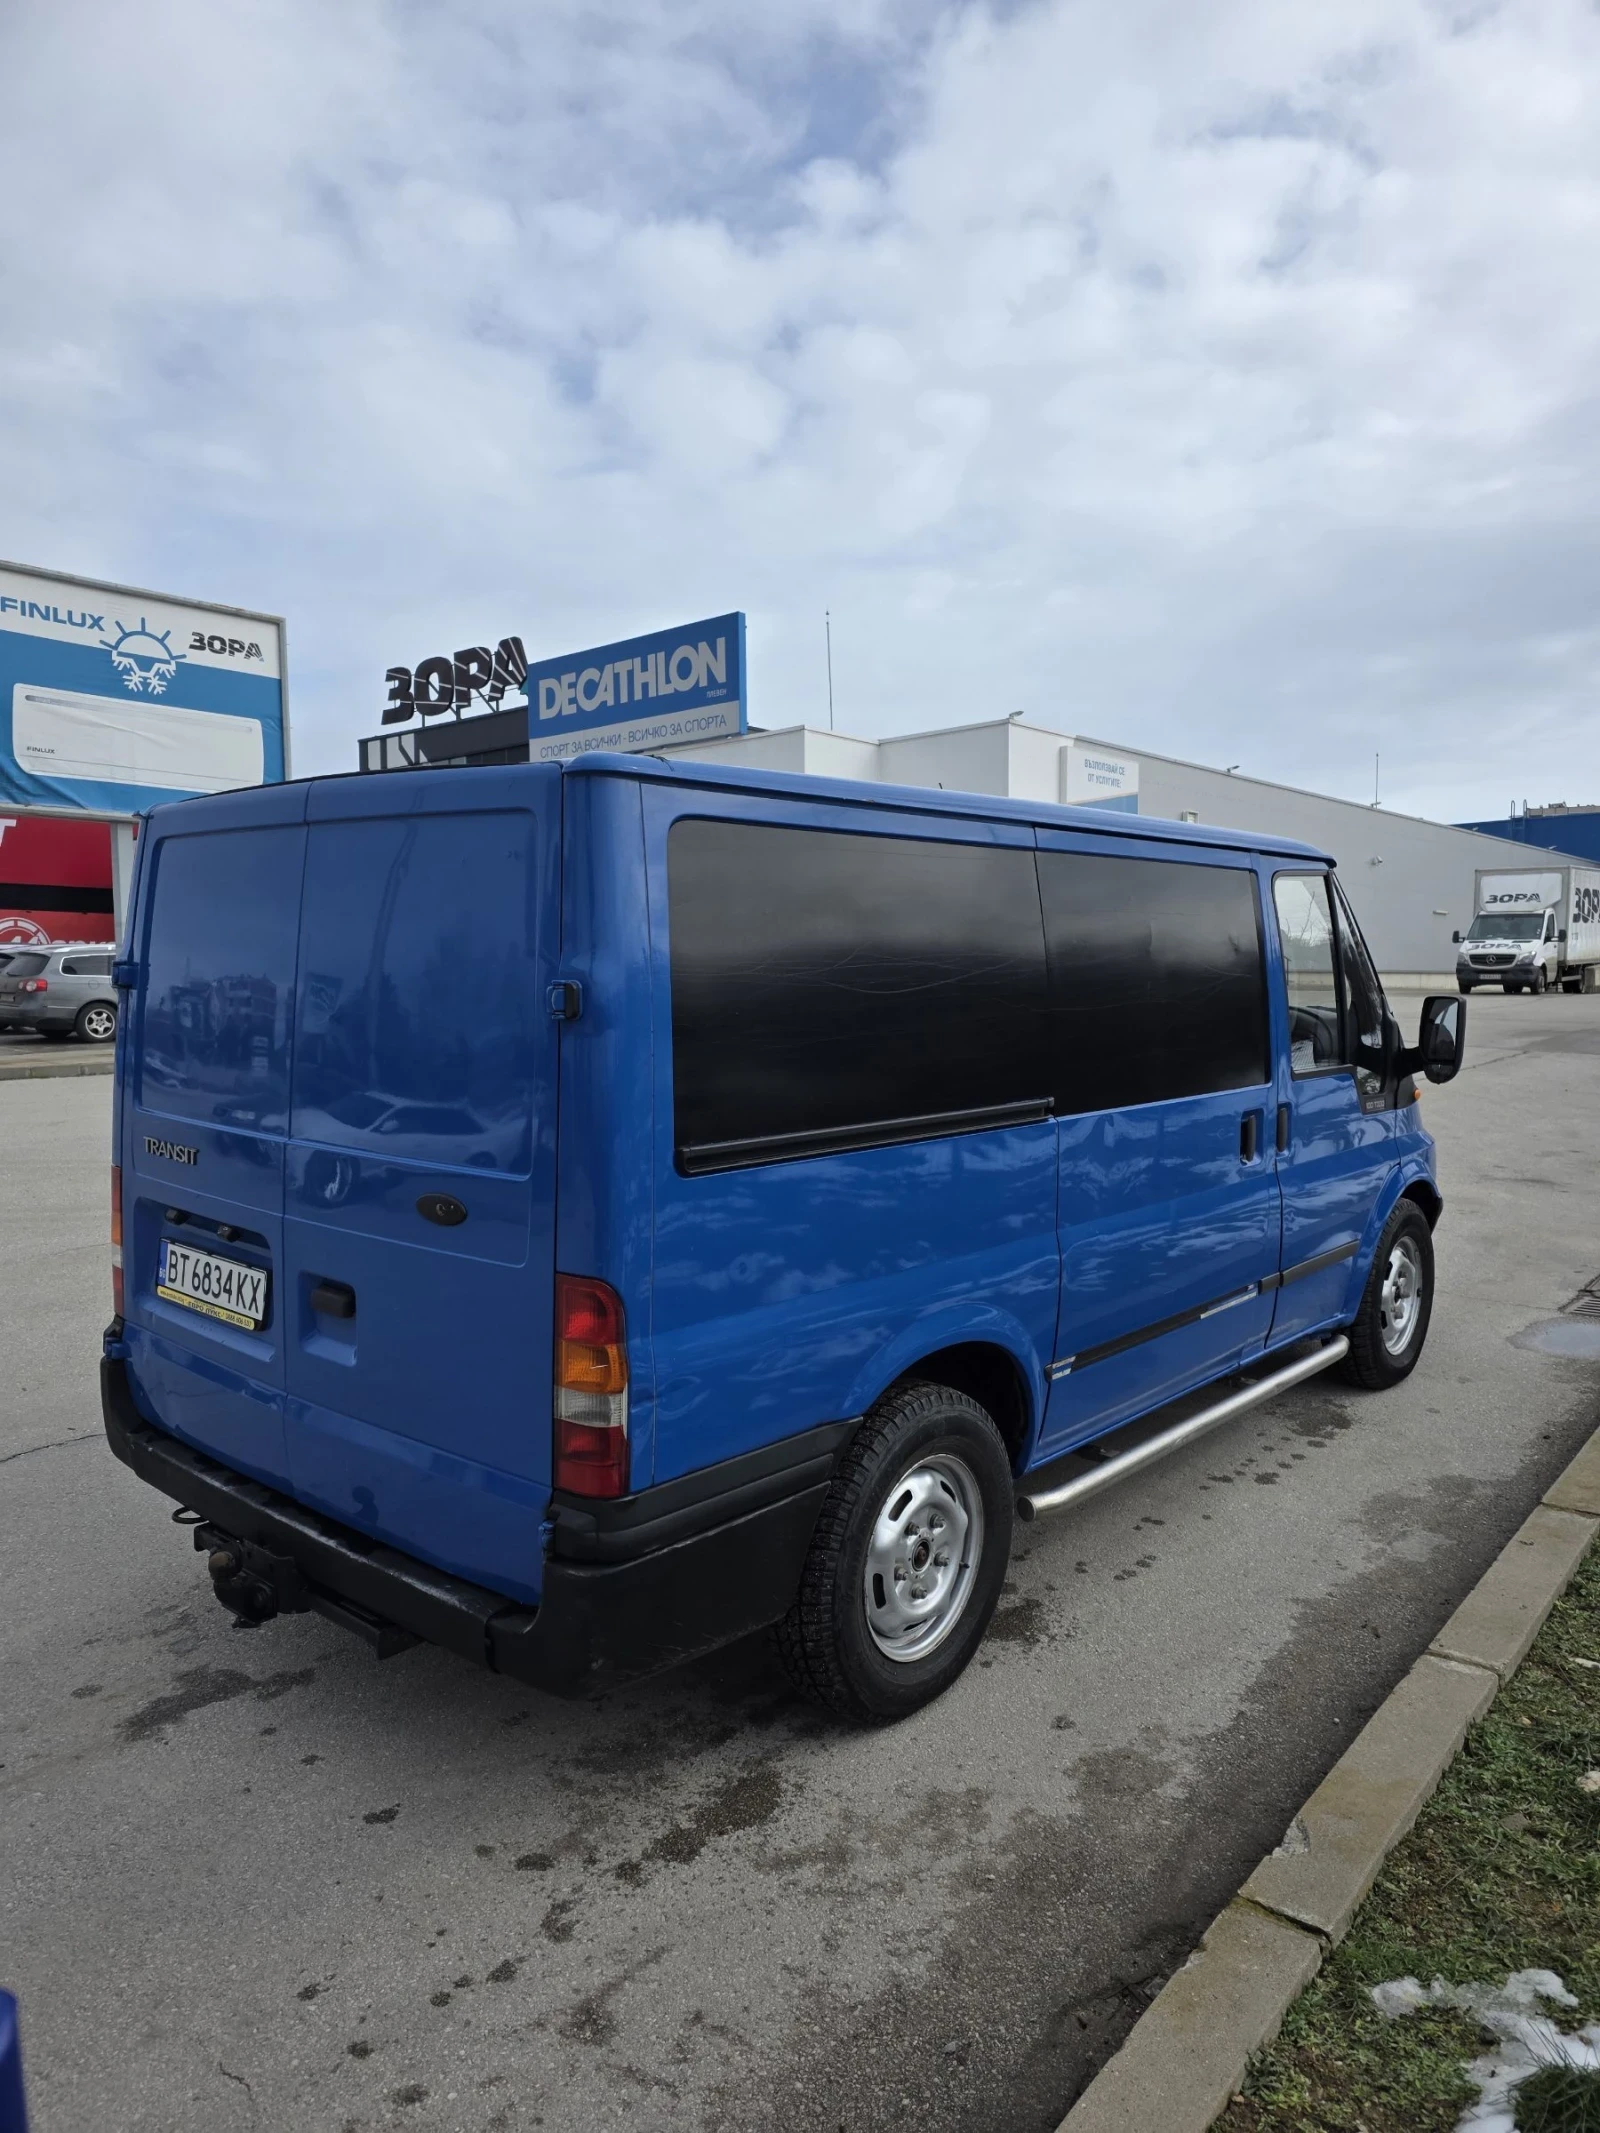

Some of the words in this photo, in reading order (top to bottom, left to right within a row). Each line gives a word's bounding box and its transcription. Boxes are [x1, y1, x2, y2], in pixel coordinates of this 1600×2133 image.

[0, 596, 105, 631] FINLUX
[189, 631, 264, 662] ЗОРА
[381, 636, 528, 726] ЗОРА
[539, 637, 726, 721] DECATHLON
[26, 745, 55, 755] FINLUX
[540, 743, 570, 759] СПОРТ
[571, 741, 584, 754] ЗА
[584, 734, 622, 752] ВСИЧКИ
[628, 725, 668, 743] ВСИЧКО
[669, 722, 683, 736] ЗА
[685, 714, 727, 733] СПОРТА
[1485, 893, 1541, 904] ЗОРА
[1573, 887, 1600, 923] ЗОР
[143, 1136, 199, 1165] TRANSIT
